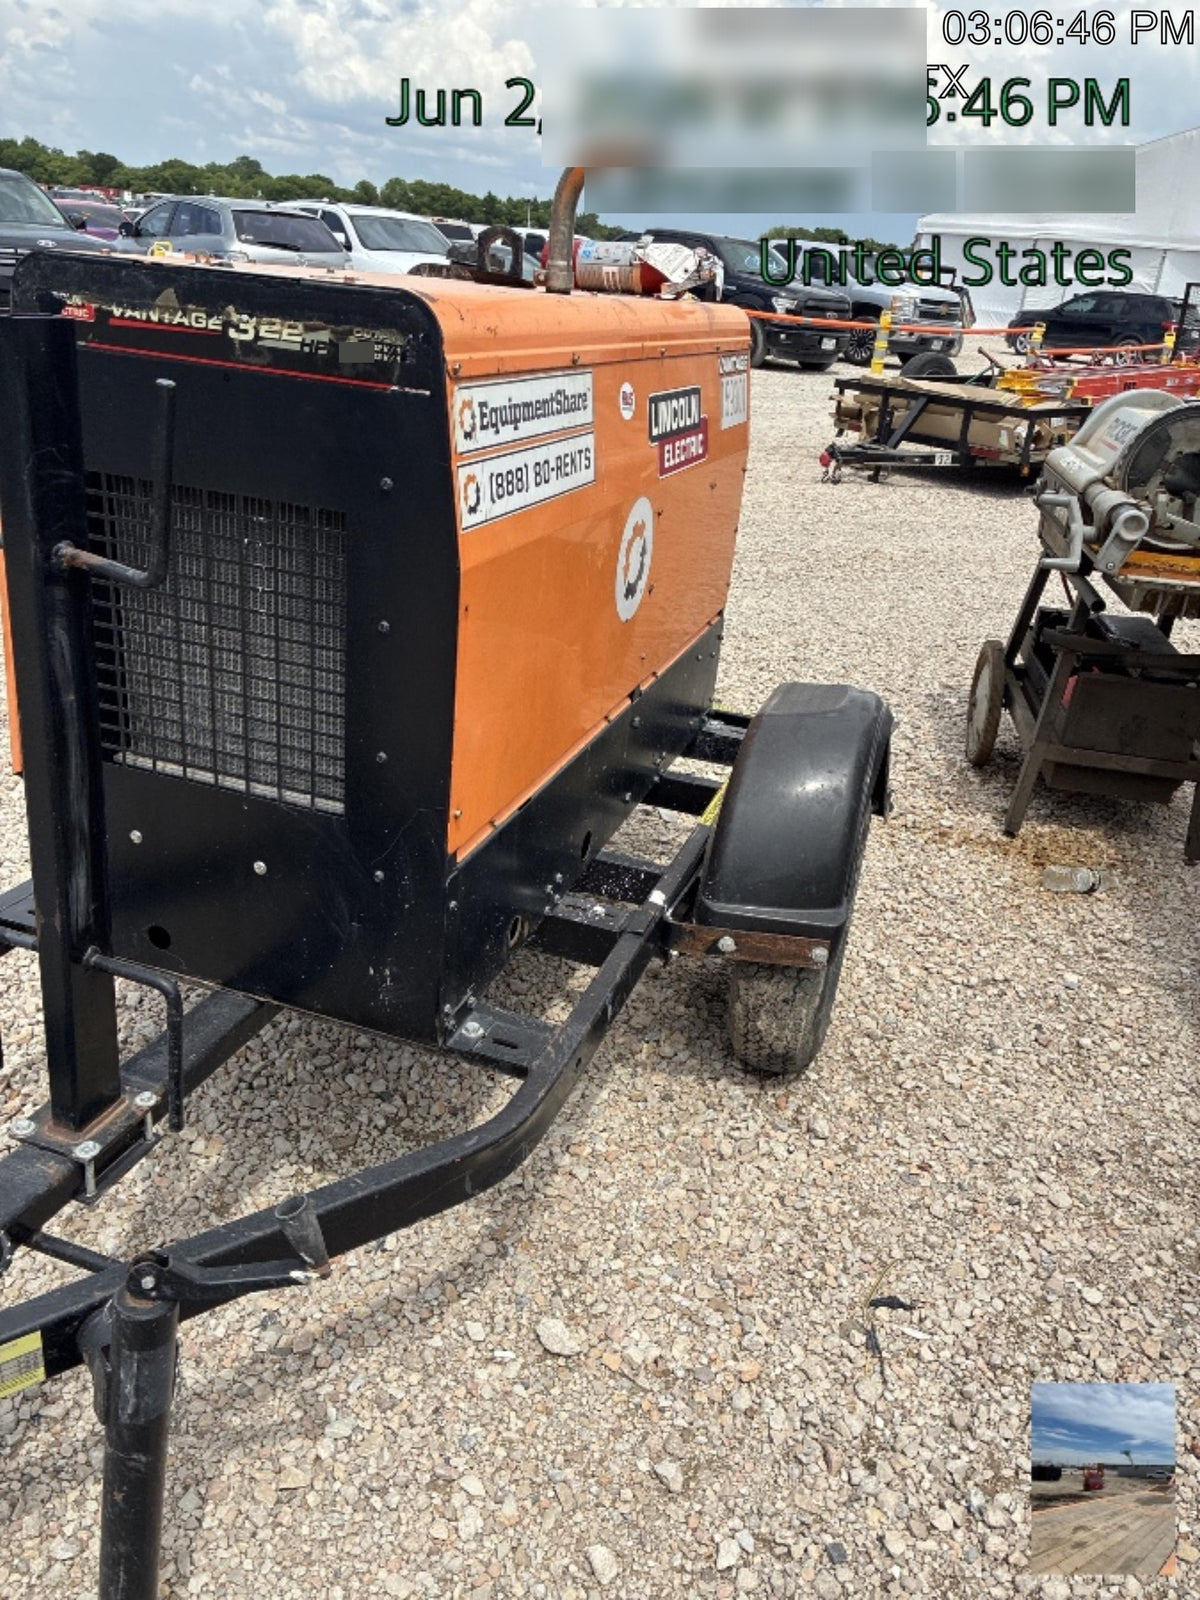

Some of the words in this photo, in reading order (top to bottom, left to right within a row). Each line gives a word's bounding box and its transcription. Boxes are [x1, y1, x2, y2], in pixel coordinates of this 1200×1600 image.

[478, 388, 588, 435] EquipmentShare
[651, 394, 700, 437] LINCOLN
[664, 432, 704, 468] ELECTRIC
[489, 461, 529, 504] (888)
